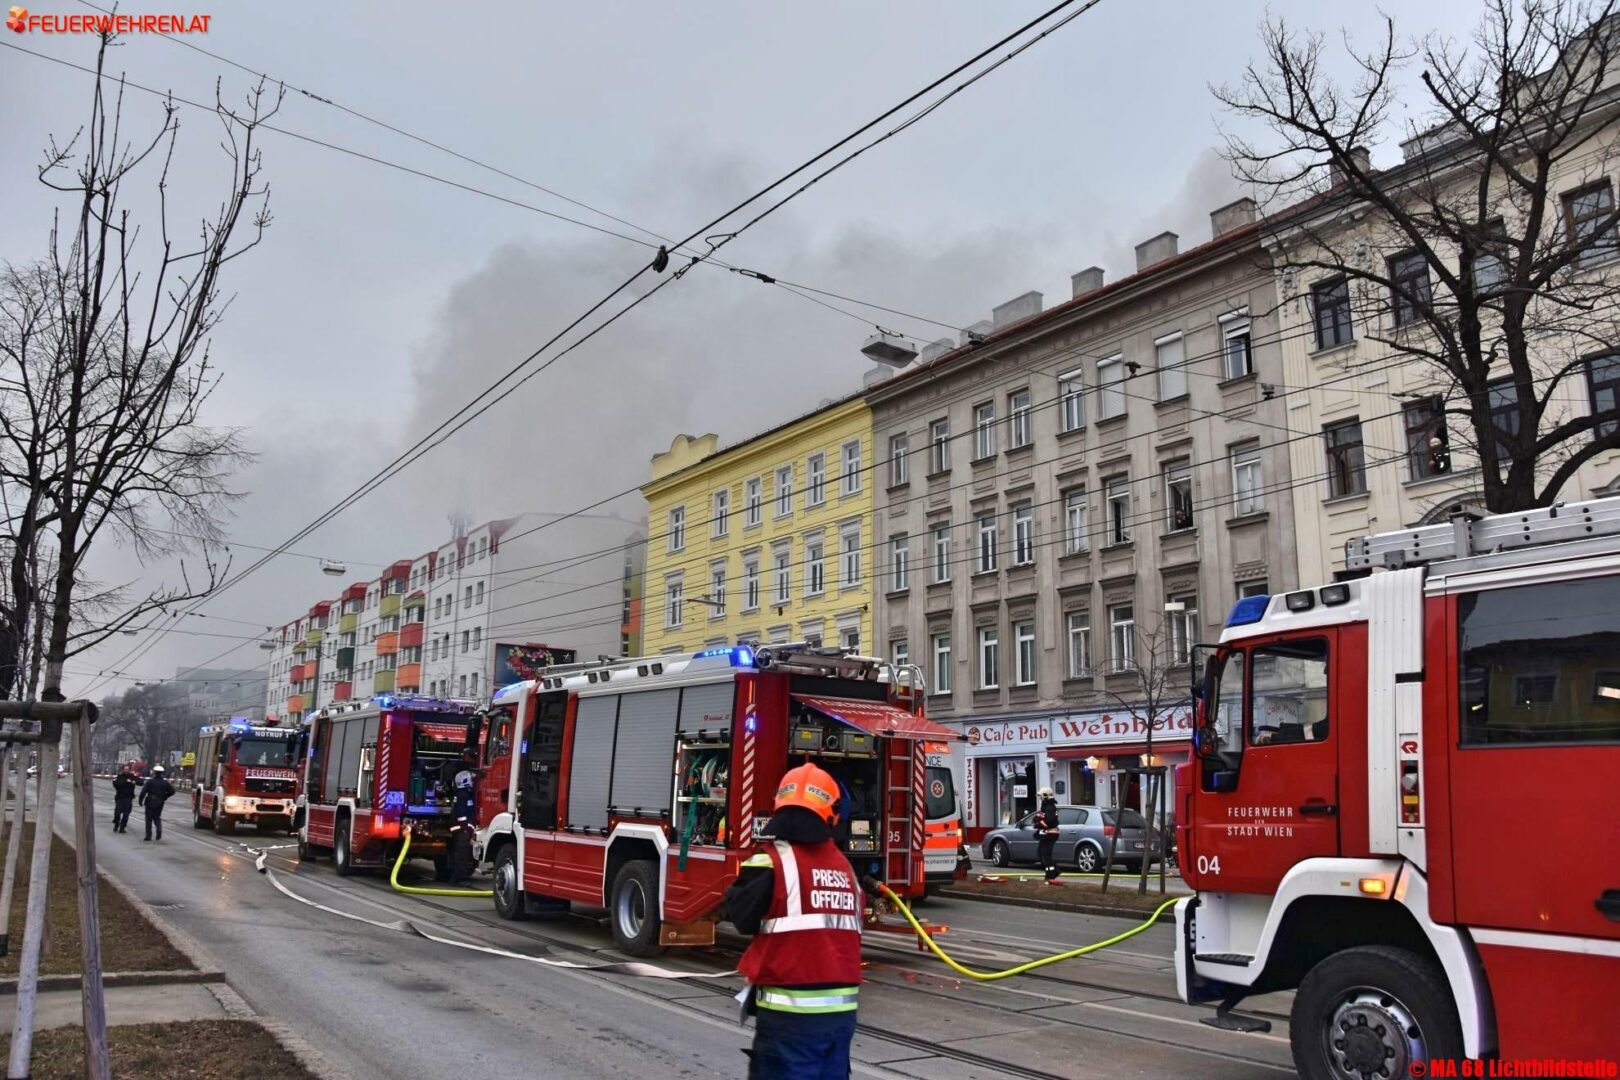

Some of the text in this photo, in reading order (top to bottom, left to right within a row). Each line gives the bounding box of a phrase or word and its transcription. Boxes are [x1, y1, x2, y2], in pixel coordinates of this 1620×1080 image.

[1019, 725, 1048, 740] Pub
[808, 786, 832, 801] WEHR
[1228, 807, 1293, 817] FEUERWEHR
[1227, 826, 1293, 837] STADT WIEN
[1197, 855, 1220, 875] 04
[812, 868, 851, 888] PRESSE
[811, 890, 854, 910] OFFIZIER
